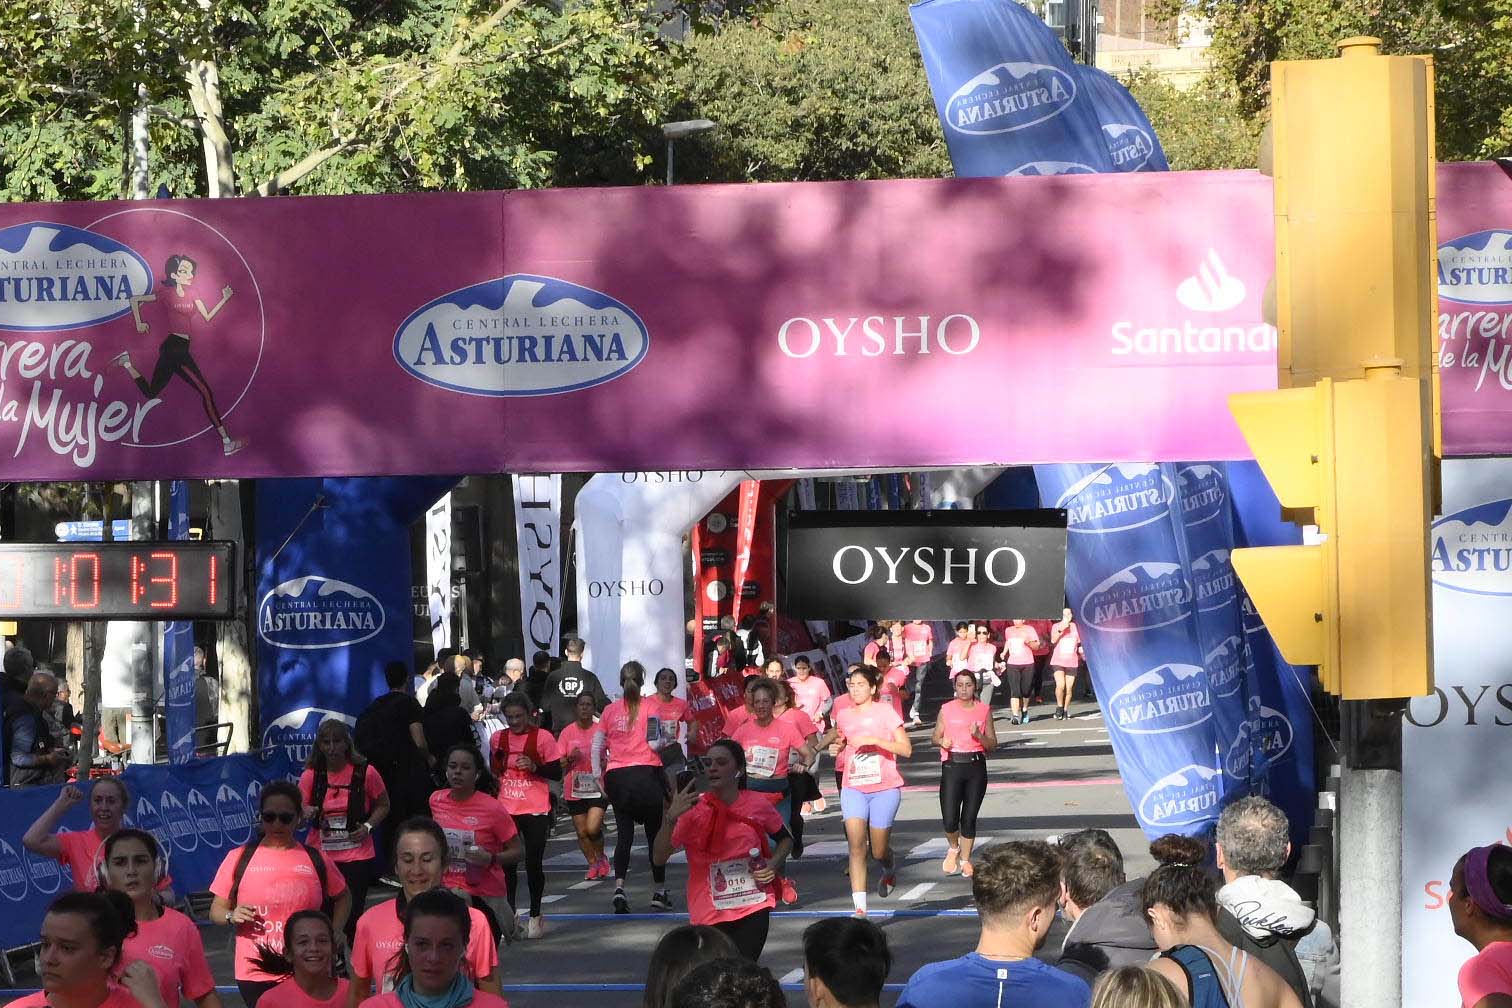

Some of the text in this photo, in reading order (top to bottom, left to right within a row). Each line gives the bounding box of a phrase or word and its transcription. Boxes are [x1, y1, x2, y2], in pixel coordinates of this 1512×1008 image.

[56, 258, 128, 271] LECHERA
[452, 315, 619, 330] CENTRAL LECHERA
[777, 313, 980, 358] OYSHO
[413, 322, 628, 366] ASTURIANA
[13, 374, 161, 468] Mujer
[832, 544, 1026, 586] OYSHO
[589, 579, 663, 598] OYSHO
[263, 605, 375, 633] ASTURIANA
[728, 877, 746, 887] 016
